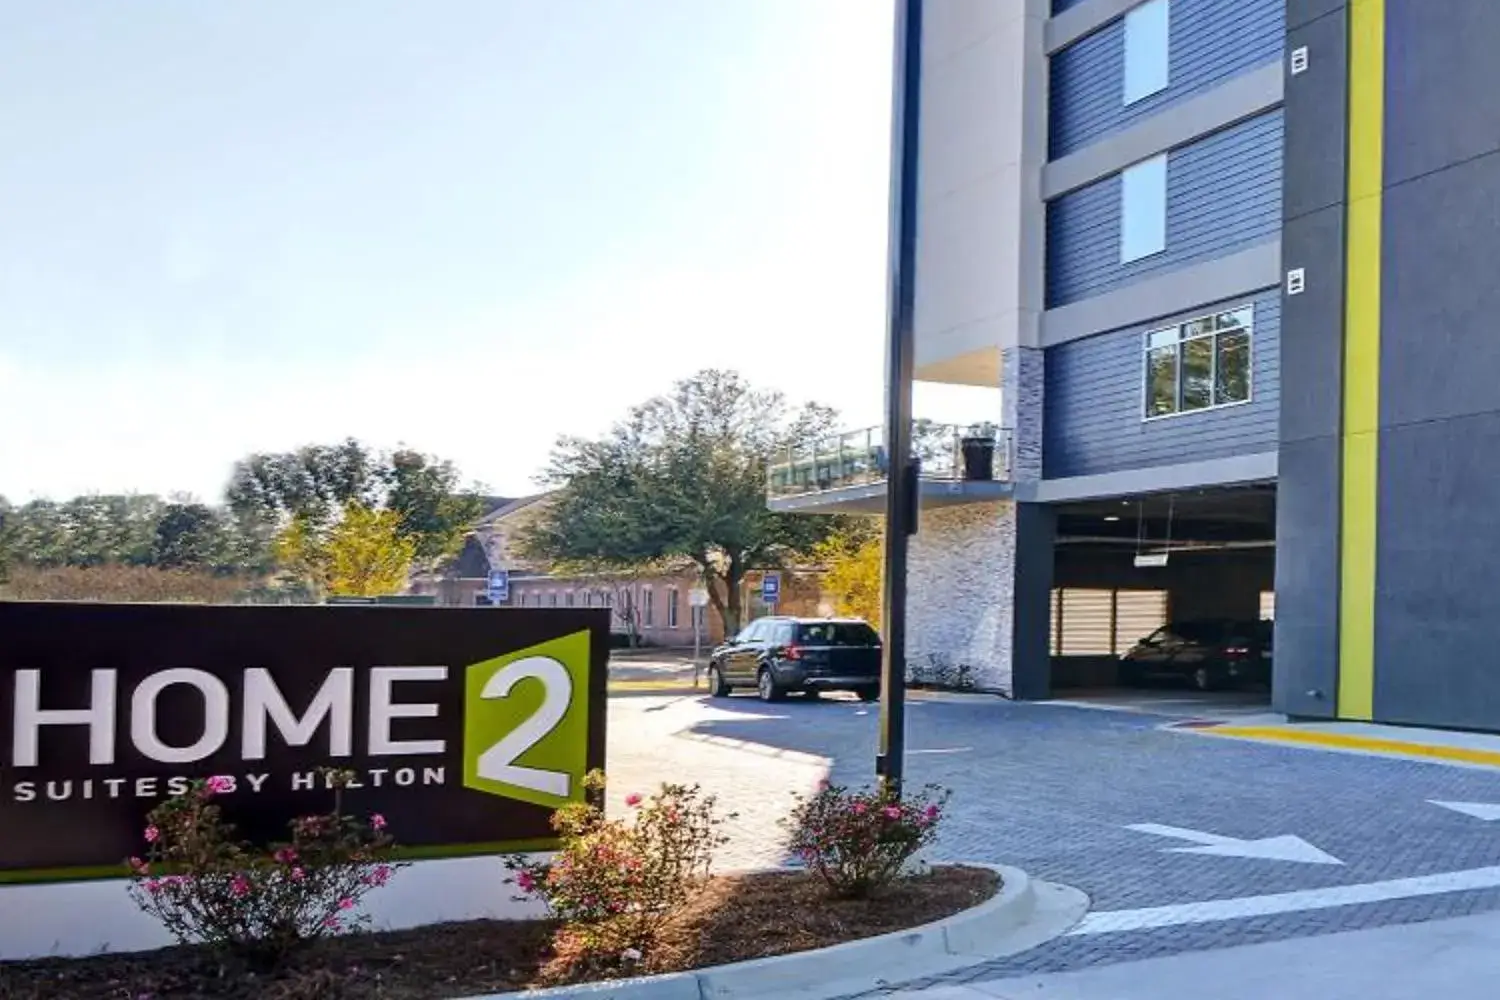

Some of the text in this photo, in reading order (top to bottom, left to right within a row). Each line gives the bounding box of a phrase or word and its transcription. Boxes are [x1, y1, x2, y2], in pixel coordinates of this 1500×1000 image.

[12, 656, 573, 798] HOME 2
[13, 775, 190, 801] SUITES
